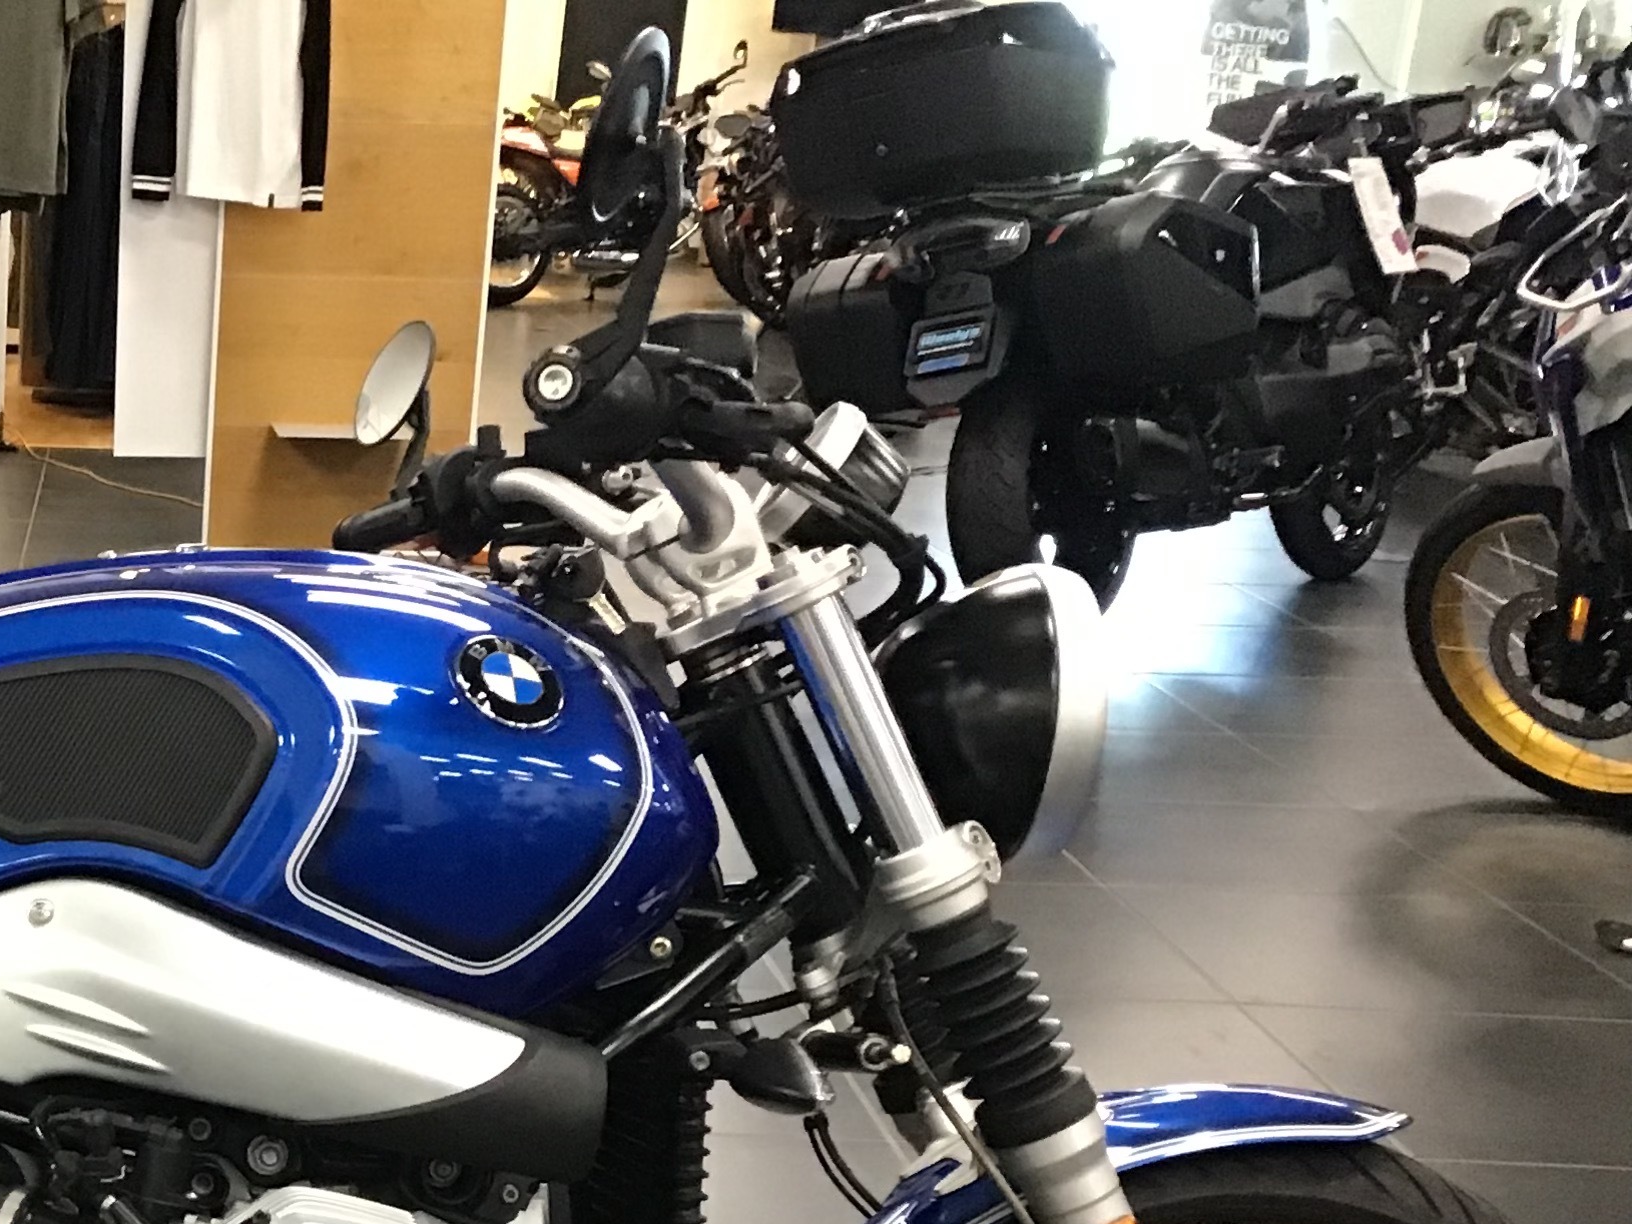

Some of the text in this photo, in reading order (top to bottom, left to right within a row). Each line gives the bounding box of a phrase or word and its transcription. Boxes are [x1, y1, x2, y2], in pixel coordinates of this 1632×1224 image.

[1211, 21, 1290, 45] GETTING
[1212, 41, 1268, 58] THERE
[1211, 56, 1264, 75] IS ALL
[1209, 73, 1242, 91] THE
